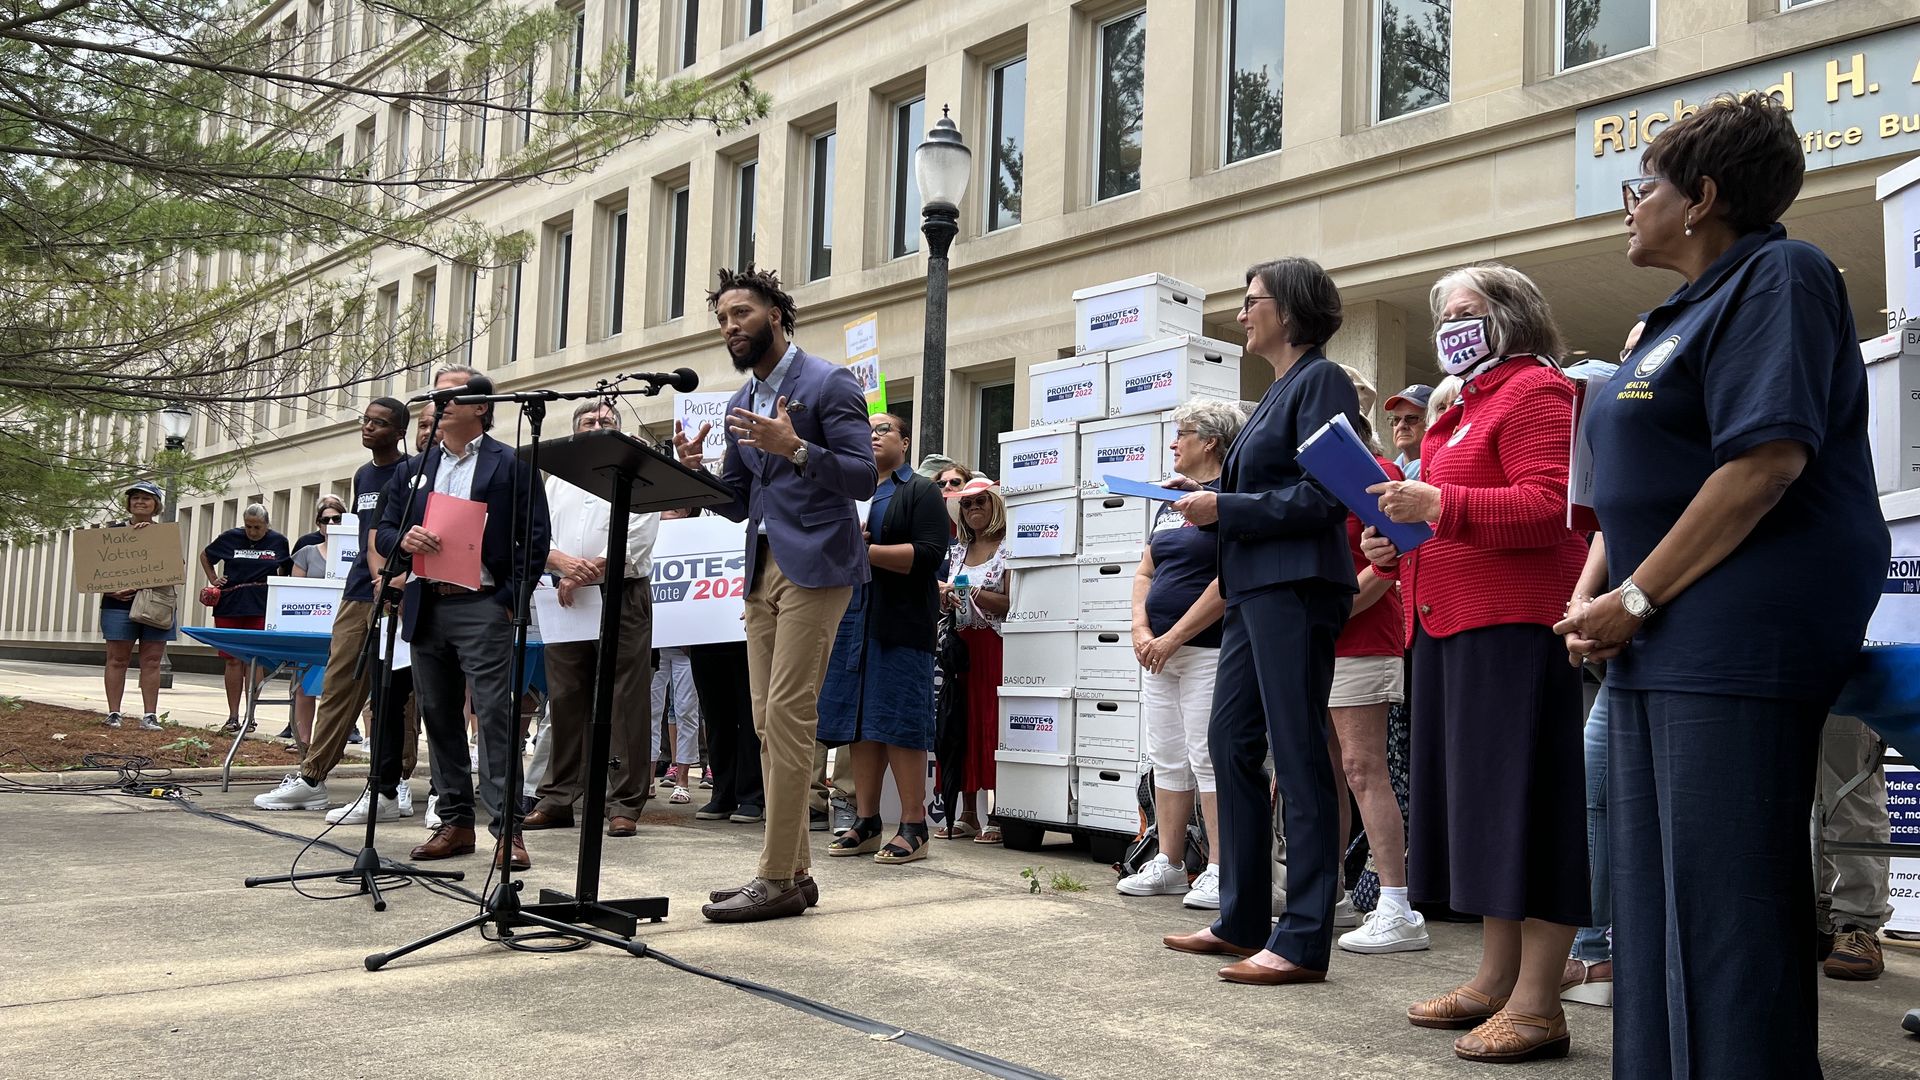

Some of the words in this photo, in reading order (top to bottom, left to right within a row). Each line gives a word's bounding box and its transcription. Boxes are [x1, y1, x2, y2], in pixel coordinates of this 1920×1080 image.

[1593, 71, 1794, 157] Richd
[1826, 53, 1880, 103] H.
[1798, 126, 1863, 154] fice
[1090, 309, 1127, 324] PROMOTE
[1120, 315, 1138, 325] 2022
[1441, 329, 1478, 350] VOTE
[1452, 347, 1478, 364] 411
[1125, 373, 1161, 387] PROMOTE
[1153, 379, 1172, 389] 2022
[1047, 383, 1082, 396] PROMOTE
[1075, 388, 1093, 398] 2022
[684, 398, 730, 416] PROTECT
[1013, 451, 1047, 462] PROMOTE
[1097, 447, 1133, 456] PROMOTE
[1040, 457, 1058, 465] 2022
[102, 532, 138, 545] Make
[97, 546, 148, 563] Voting
[93, 560, 164, 580] Accessible!
[651, 585, 680, 601] Vote
[1903, 580, 1915, 593] the
[1007, 611, 1028, 620] BASIC
[1028, 611, 1048, 620] DUTY
[1003, 677, 1025, 685] BASIC
[1026, 676, 1046, 685] DUTY
[1010, 716, 1043, 724] PROMOTE
[1036, 724, 1053, 732] 2022
[1077, 757, 1091, 765] BASIC
[1091, 758, 1104, 766] DUTY
[1885, 780, 1916, 791] Make
[996, 806, 1018, 816] BASIC
[1018, 808, 1038, 819] DUTY
